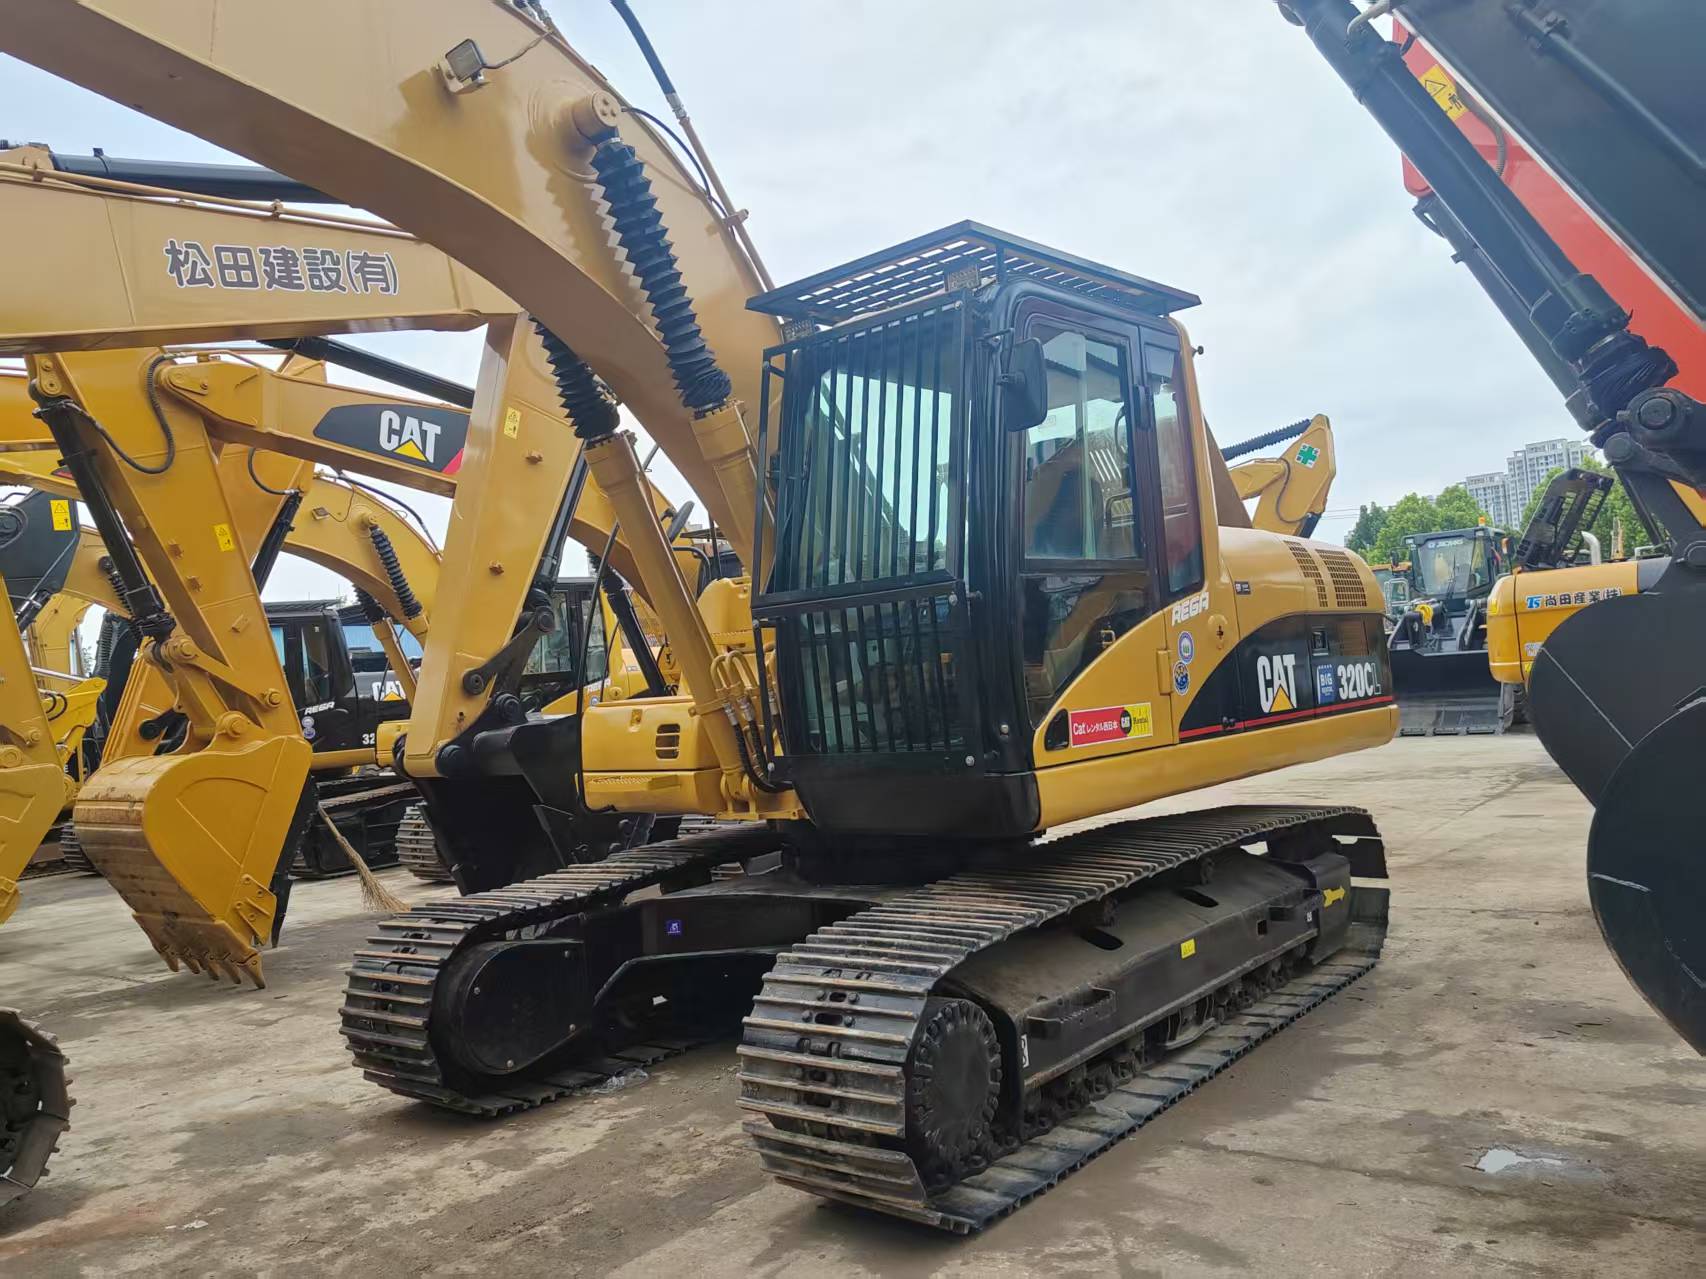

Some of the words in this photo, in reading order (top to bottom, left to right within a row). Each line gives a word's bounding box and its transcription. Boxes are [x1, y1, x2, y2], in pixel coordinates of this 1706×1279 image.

[163, 239, 399, 295] 松田建設(有)
[379, 410, 441, 463] CAT
[1256, 654, 1297, 713] CAT
[1073, 722, 1087, 735] Cat
